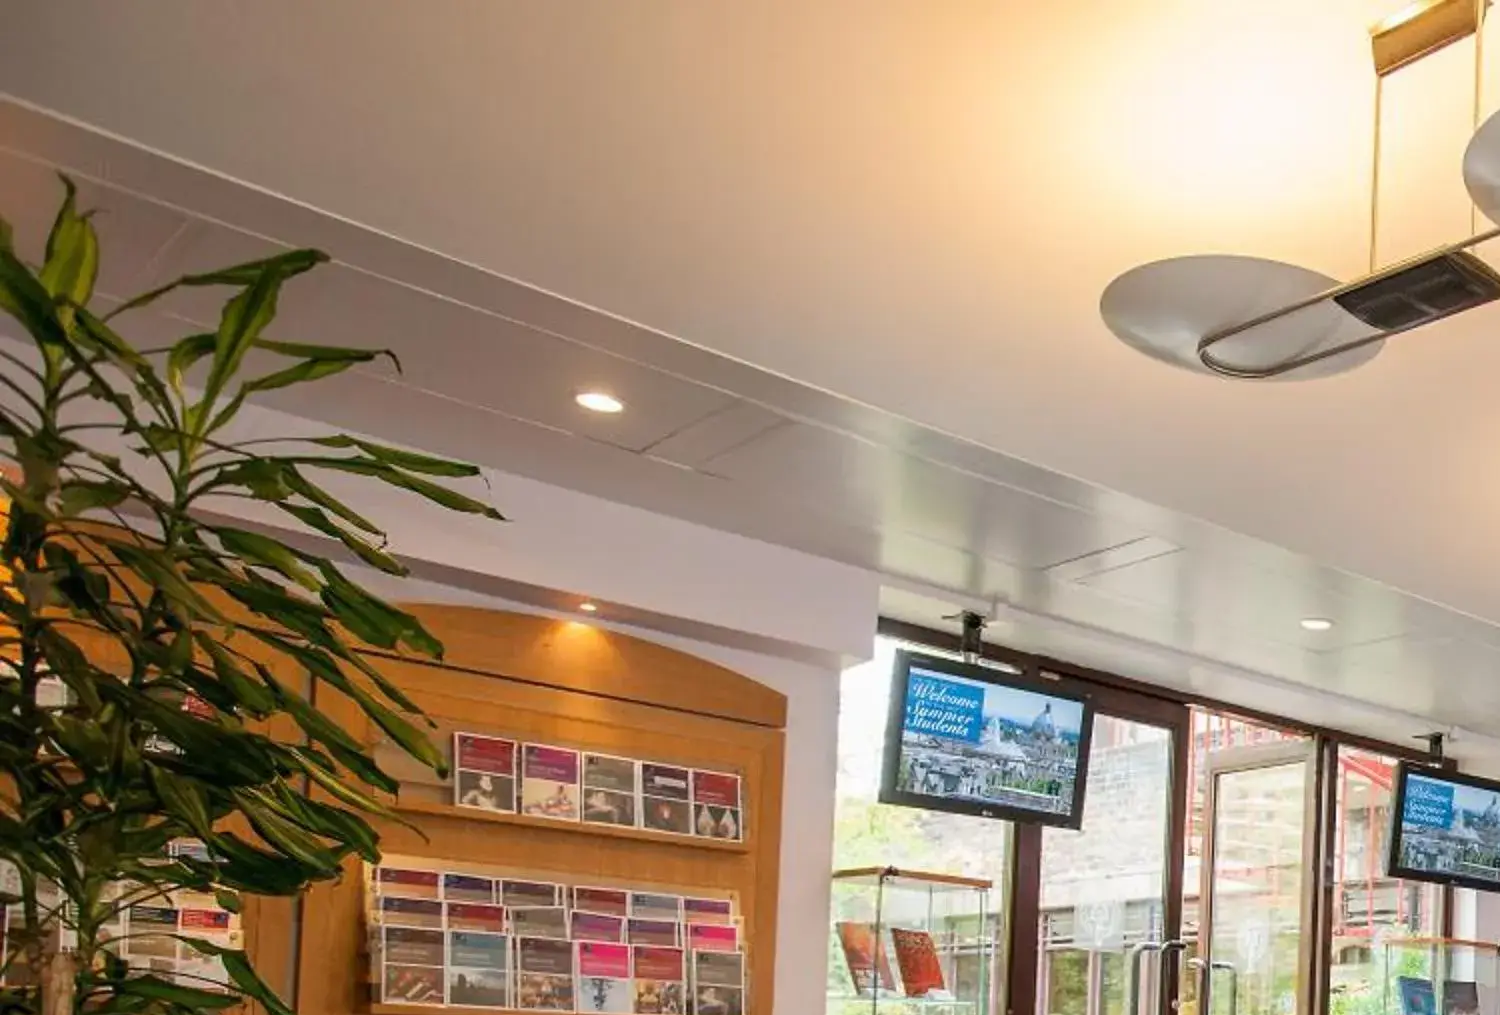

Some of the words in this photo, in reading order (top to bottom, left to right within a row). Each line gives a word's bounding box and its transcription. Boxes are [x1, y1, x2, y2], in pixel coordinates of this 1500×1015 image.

[913, 682, 978, 709] Welcome
[907, 700, 974, 725] Summer
[905, 714, 968, 737] Students
